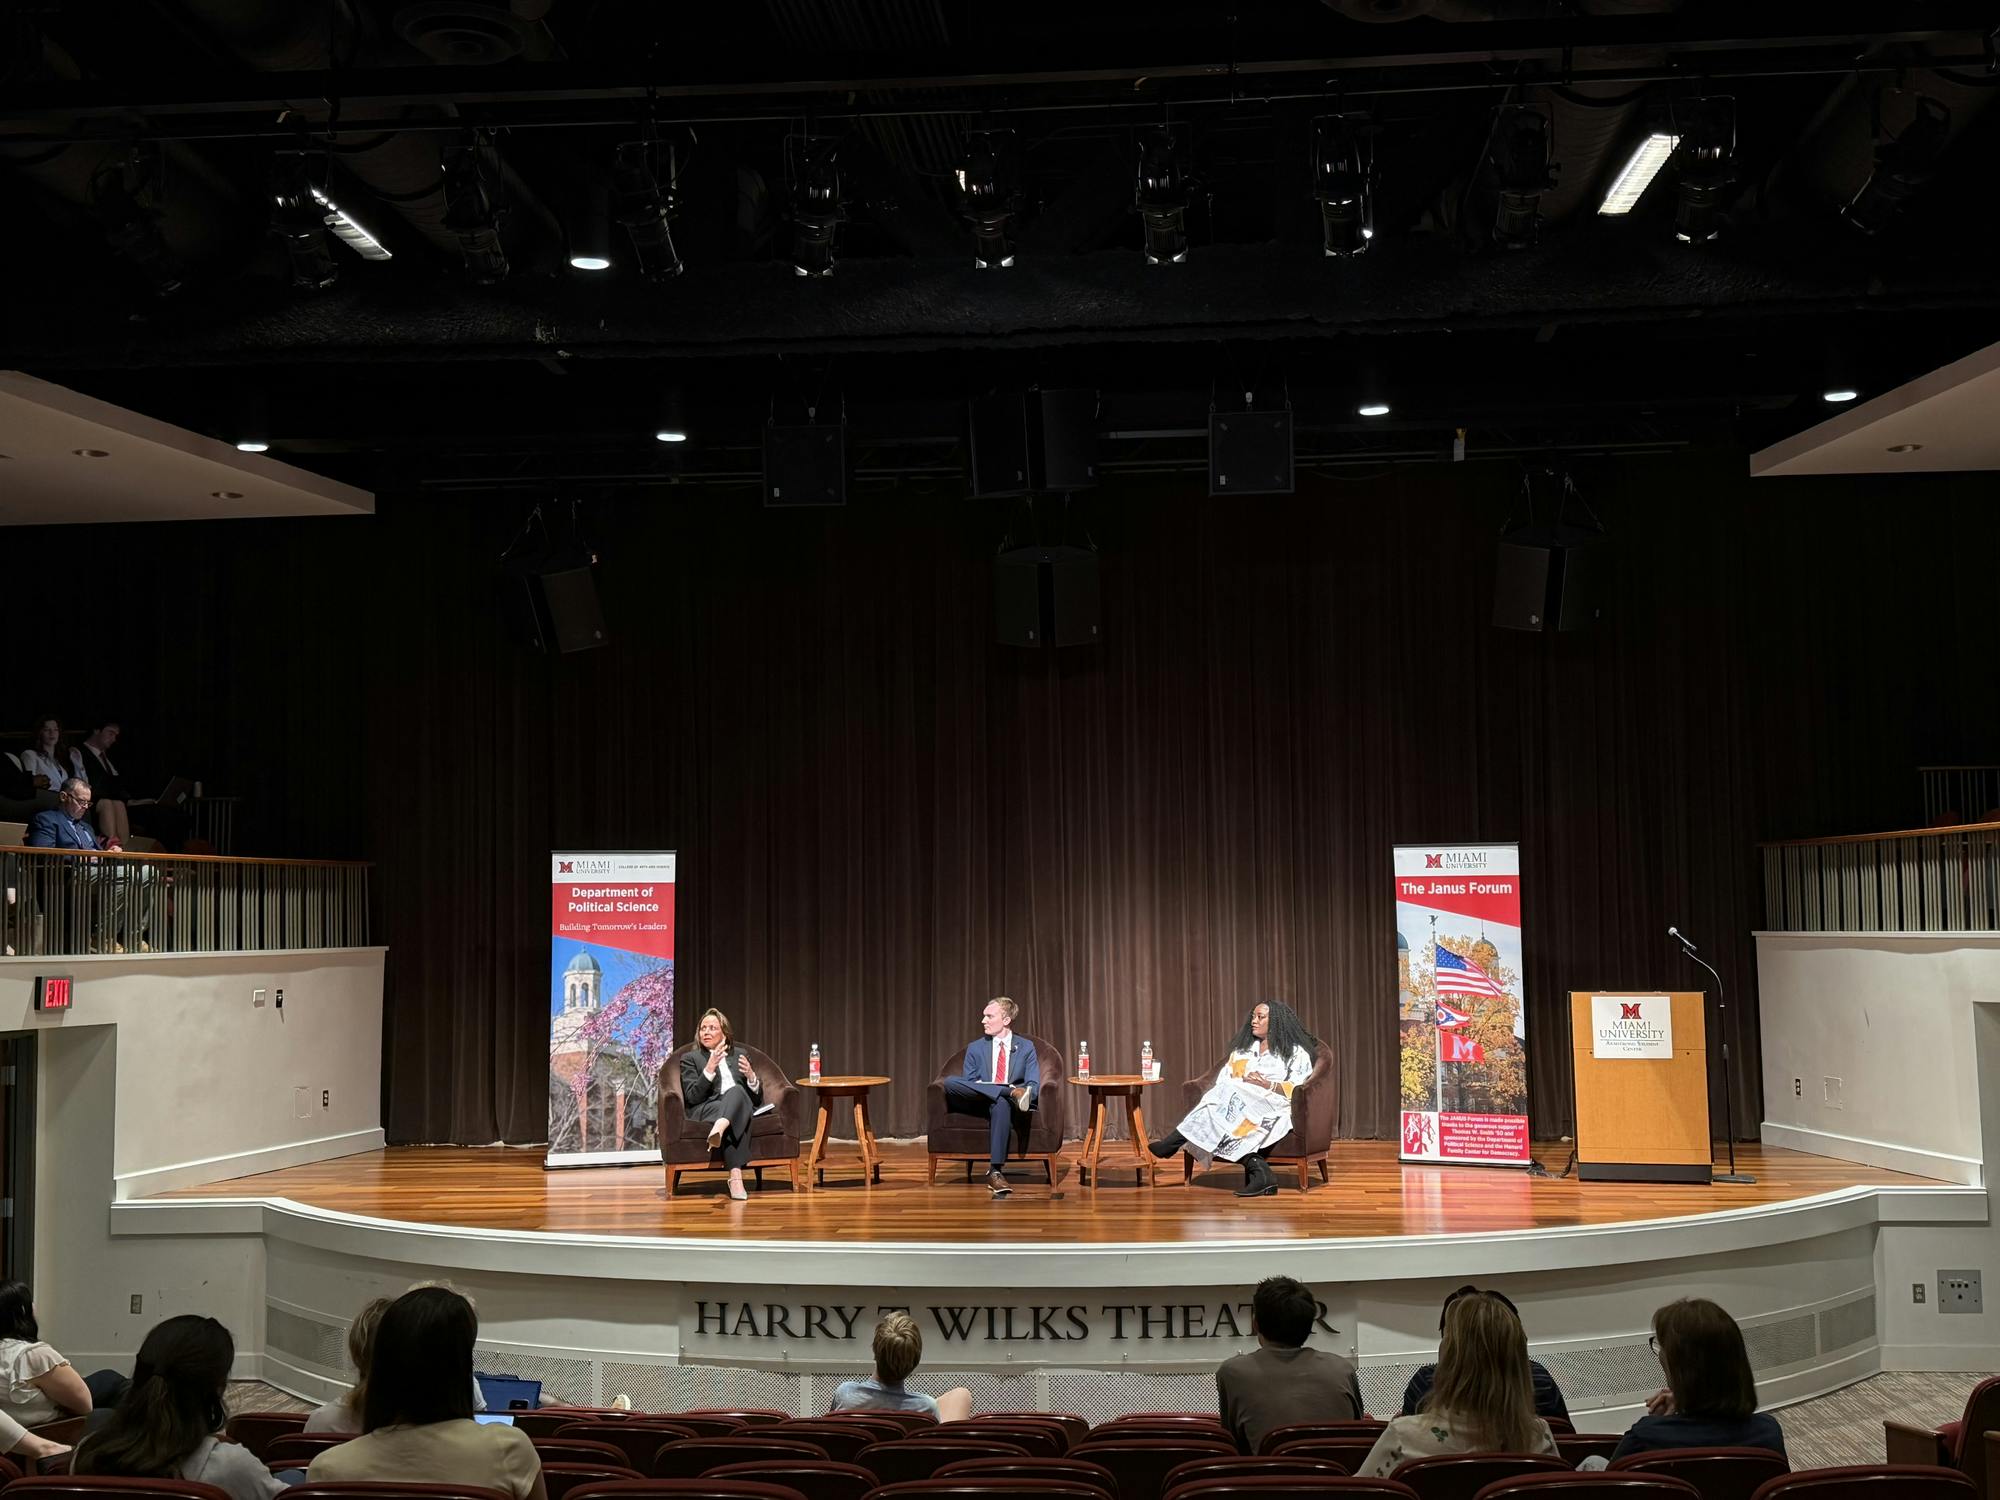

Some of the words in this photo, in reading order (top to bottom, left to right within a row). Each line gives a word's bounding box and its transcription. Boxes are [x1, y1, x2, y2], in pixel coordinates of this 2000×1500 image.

[1446, 852, 1487, 863] MIAMI
[576, 861, 610, 869] MIAMI
[572, 888, 639, 899] Department
[641, 887, 654, 897] of
[1401, 882, 1425, 894] The
[1428, 882, 1466, 894] Janus
[1469, 882, 1513, 894] Forum
[568, 902, 614, 912] Political
[616, 902, 659, 912] Science
[559, 923, 591, 933] Building
[592, 923, 637, 931] Tomorrow's
[638, 922, 668, 930] Leaders
[45, 979, 70, 1008] EXIT
[1620, 1003, 1642, 1020] M
[1612, 1021, 1651, 1030] MIAMI
[1600, 1030, 1665, 1038] UNIVERSITY
[694, 1301, 865, 1339] HARRY
[926, 1305, 1090, 1341] WILKS
[1102, 1301, 1341, 1340] THEATR
